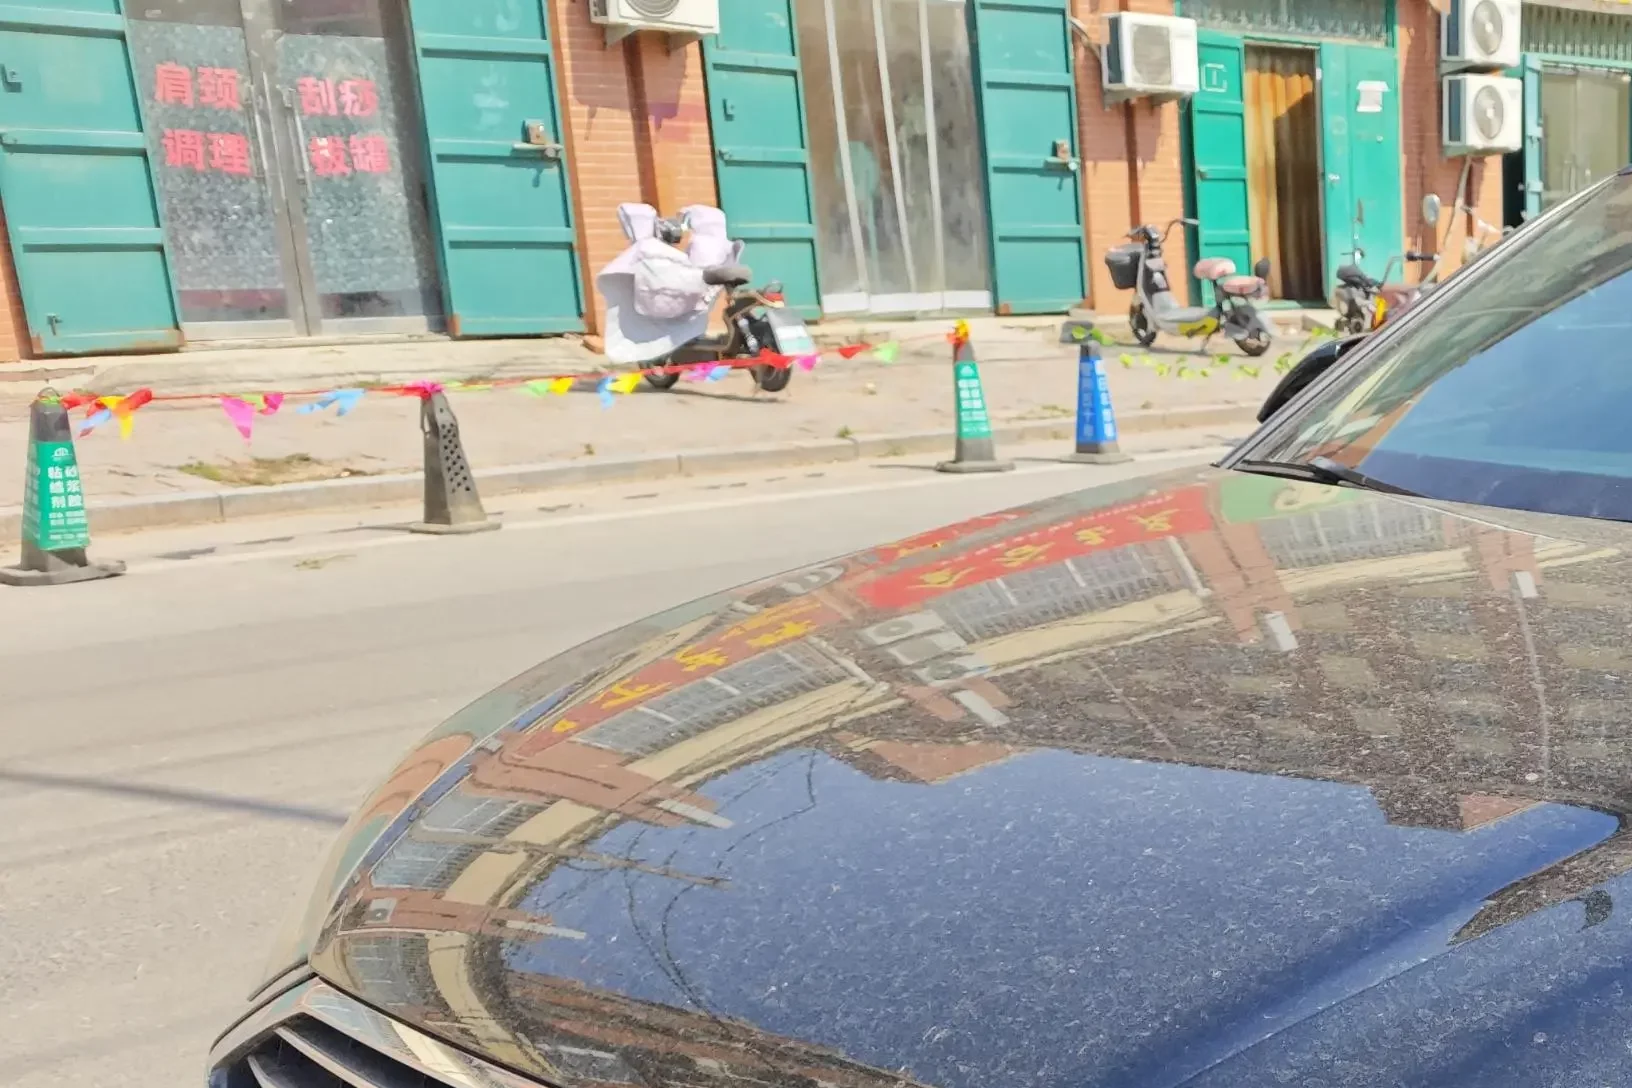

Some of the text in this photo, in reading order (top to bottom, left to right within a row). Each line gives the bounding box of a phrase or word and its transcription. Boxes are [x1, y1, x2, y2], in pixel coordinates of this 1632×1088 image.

[154, 61, 240, 110] 肩颈
[297, 76, 379, 116] 刮痧
[162, 128, 252, 176] 调理
[308, 133, 392, 176] 拔罐
